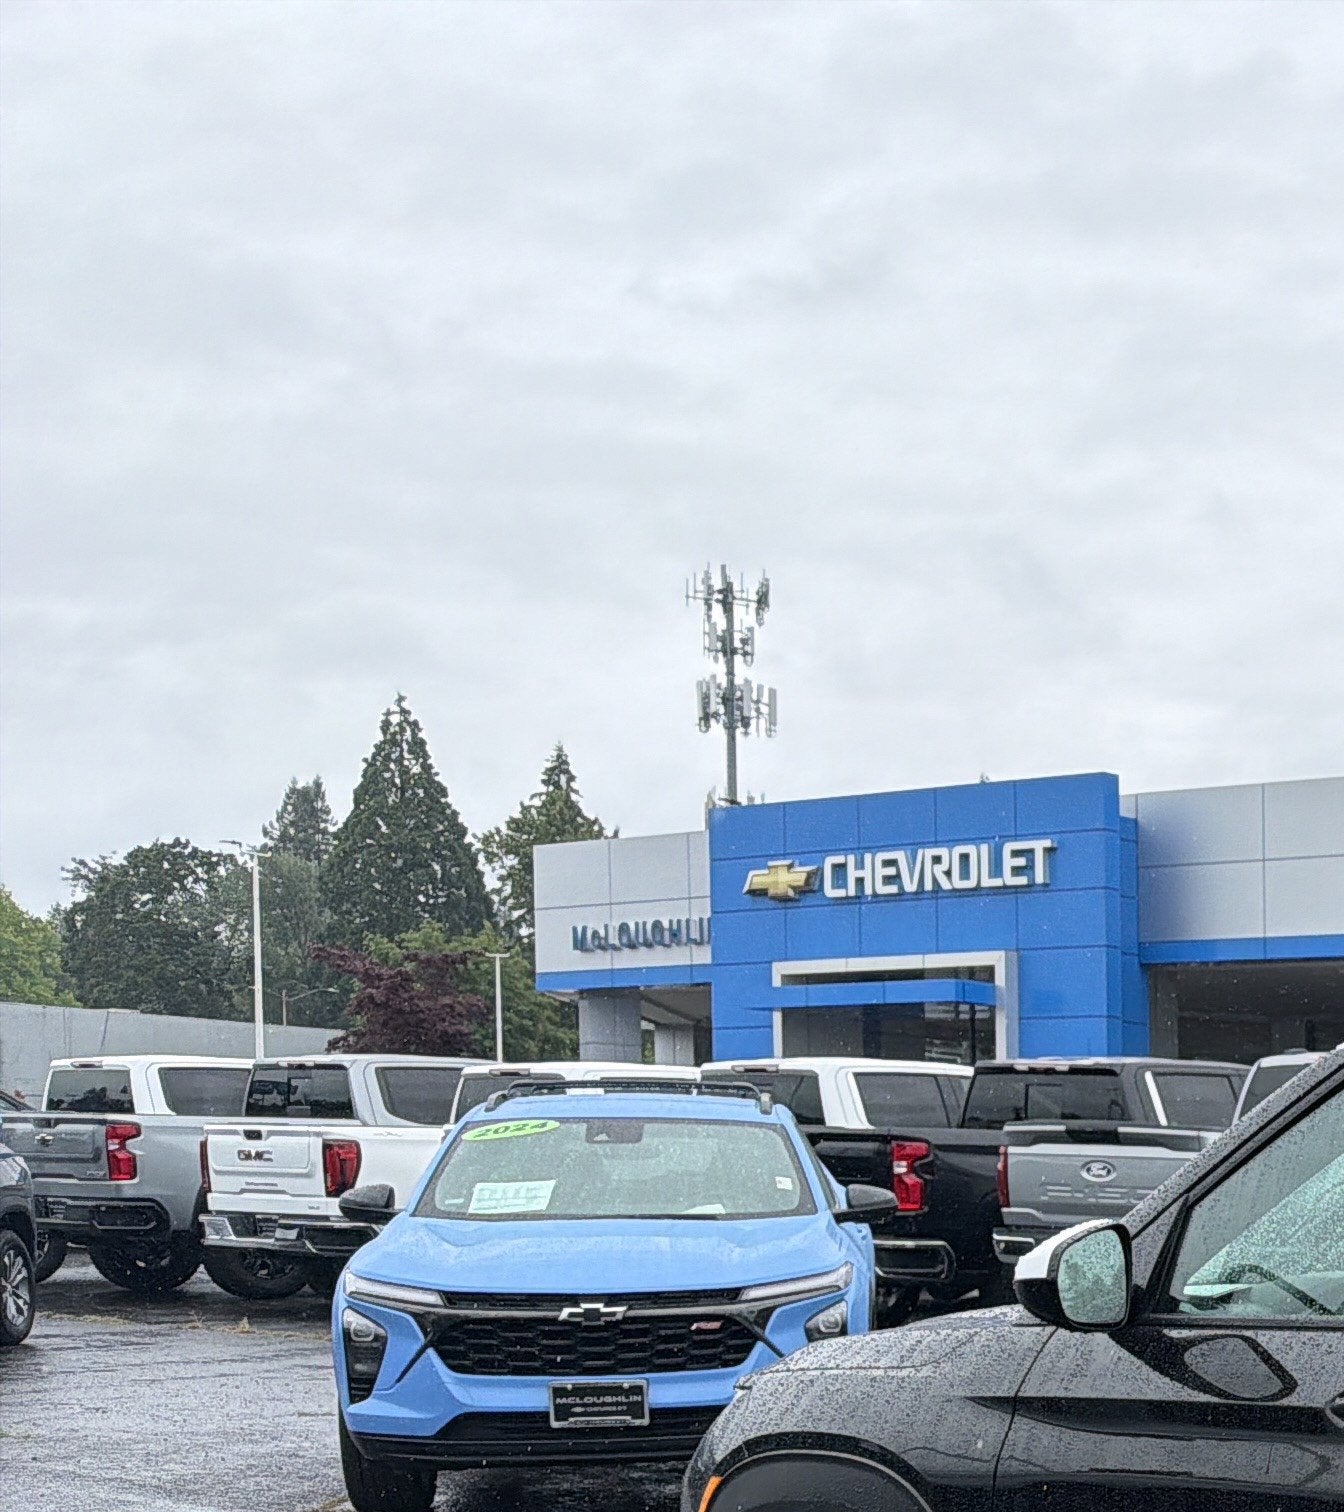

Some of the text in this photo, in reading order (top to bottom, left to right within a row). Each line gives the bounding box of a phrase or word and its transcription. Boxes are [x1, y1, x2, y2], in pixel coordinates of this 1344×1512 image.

[823, 838, 1053, 898] CHEVROLET
[472, 1121, 549, 1138] 2024
[237, 1149, 274, 1162] GMC
[555, 1394, 642, 1404] MCLOUGHLIN
